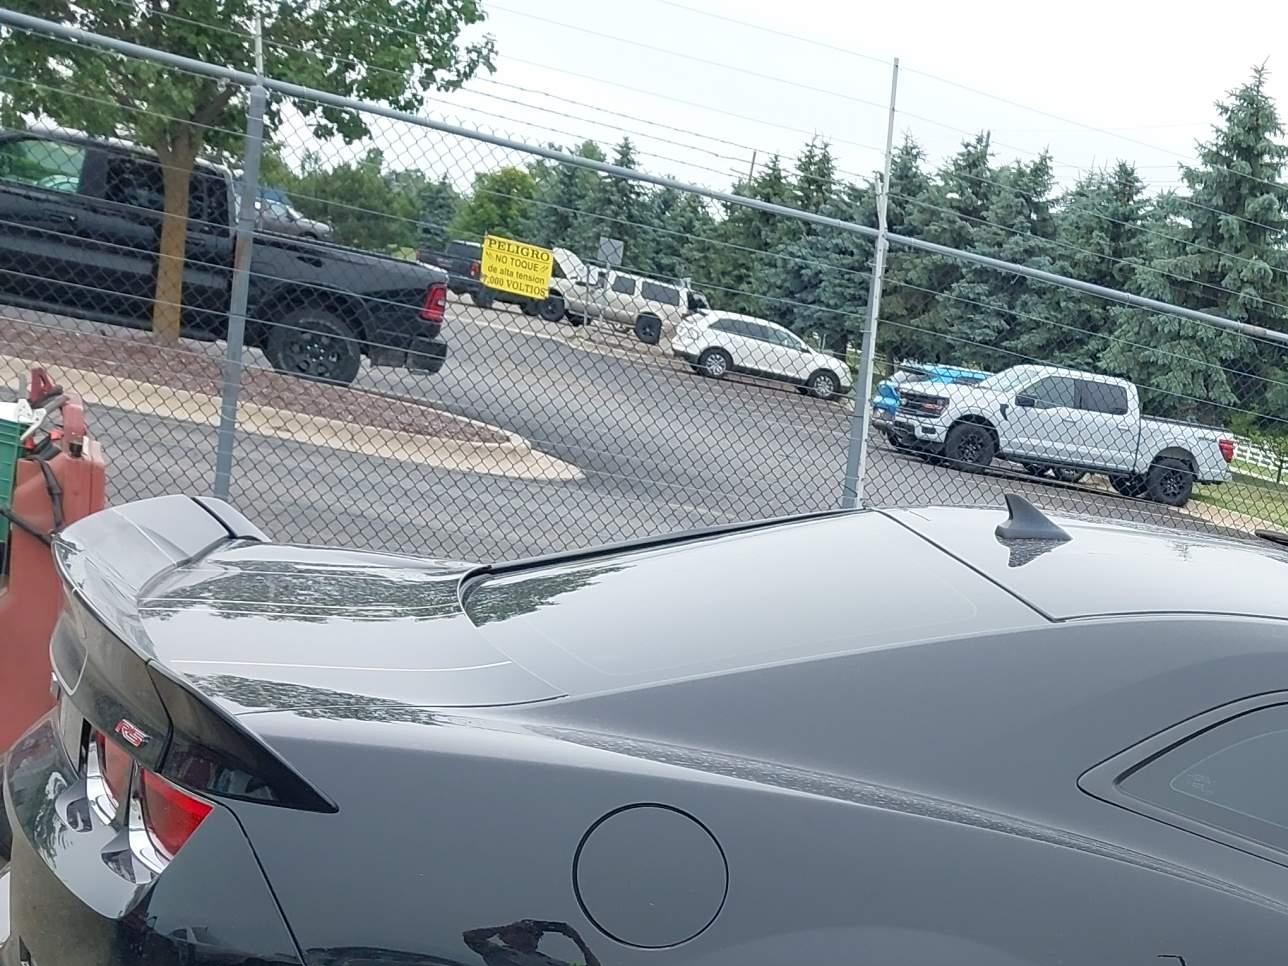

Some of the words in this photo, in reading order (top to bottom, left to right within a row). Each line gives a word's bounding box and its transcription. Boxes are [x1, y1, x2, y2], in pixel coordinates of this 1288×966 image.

[488, 239, 550, 261] PELIGRO
[495, 254, 508, 264] NO
[510, 257, 539, 272] TOQUE
[487, 264, 498, 273] de
[499, 266, 514, 276] alta
[515, 272, 545, 285] tension
[506, 280, 546, 297] VOLTIOS
[114, 718, 151, 748] RS
